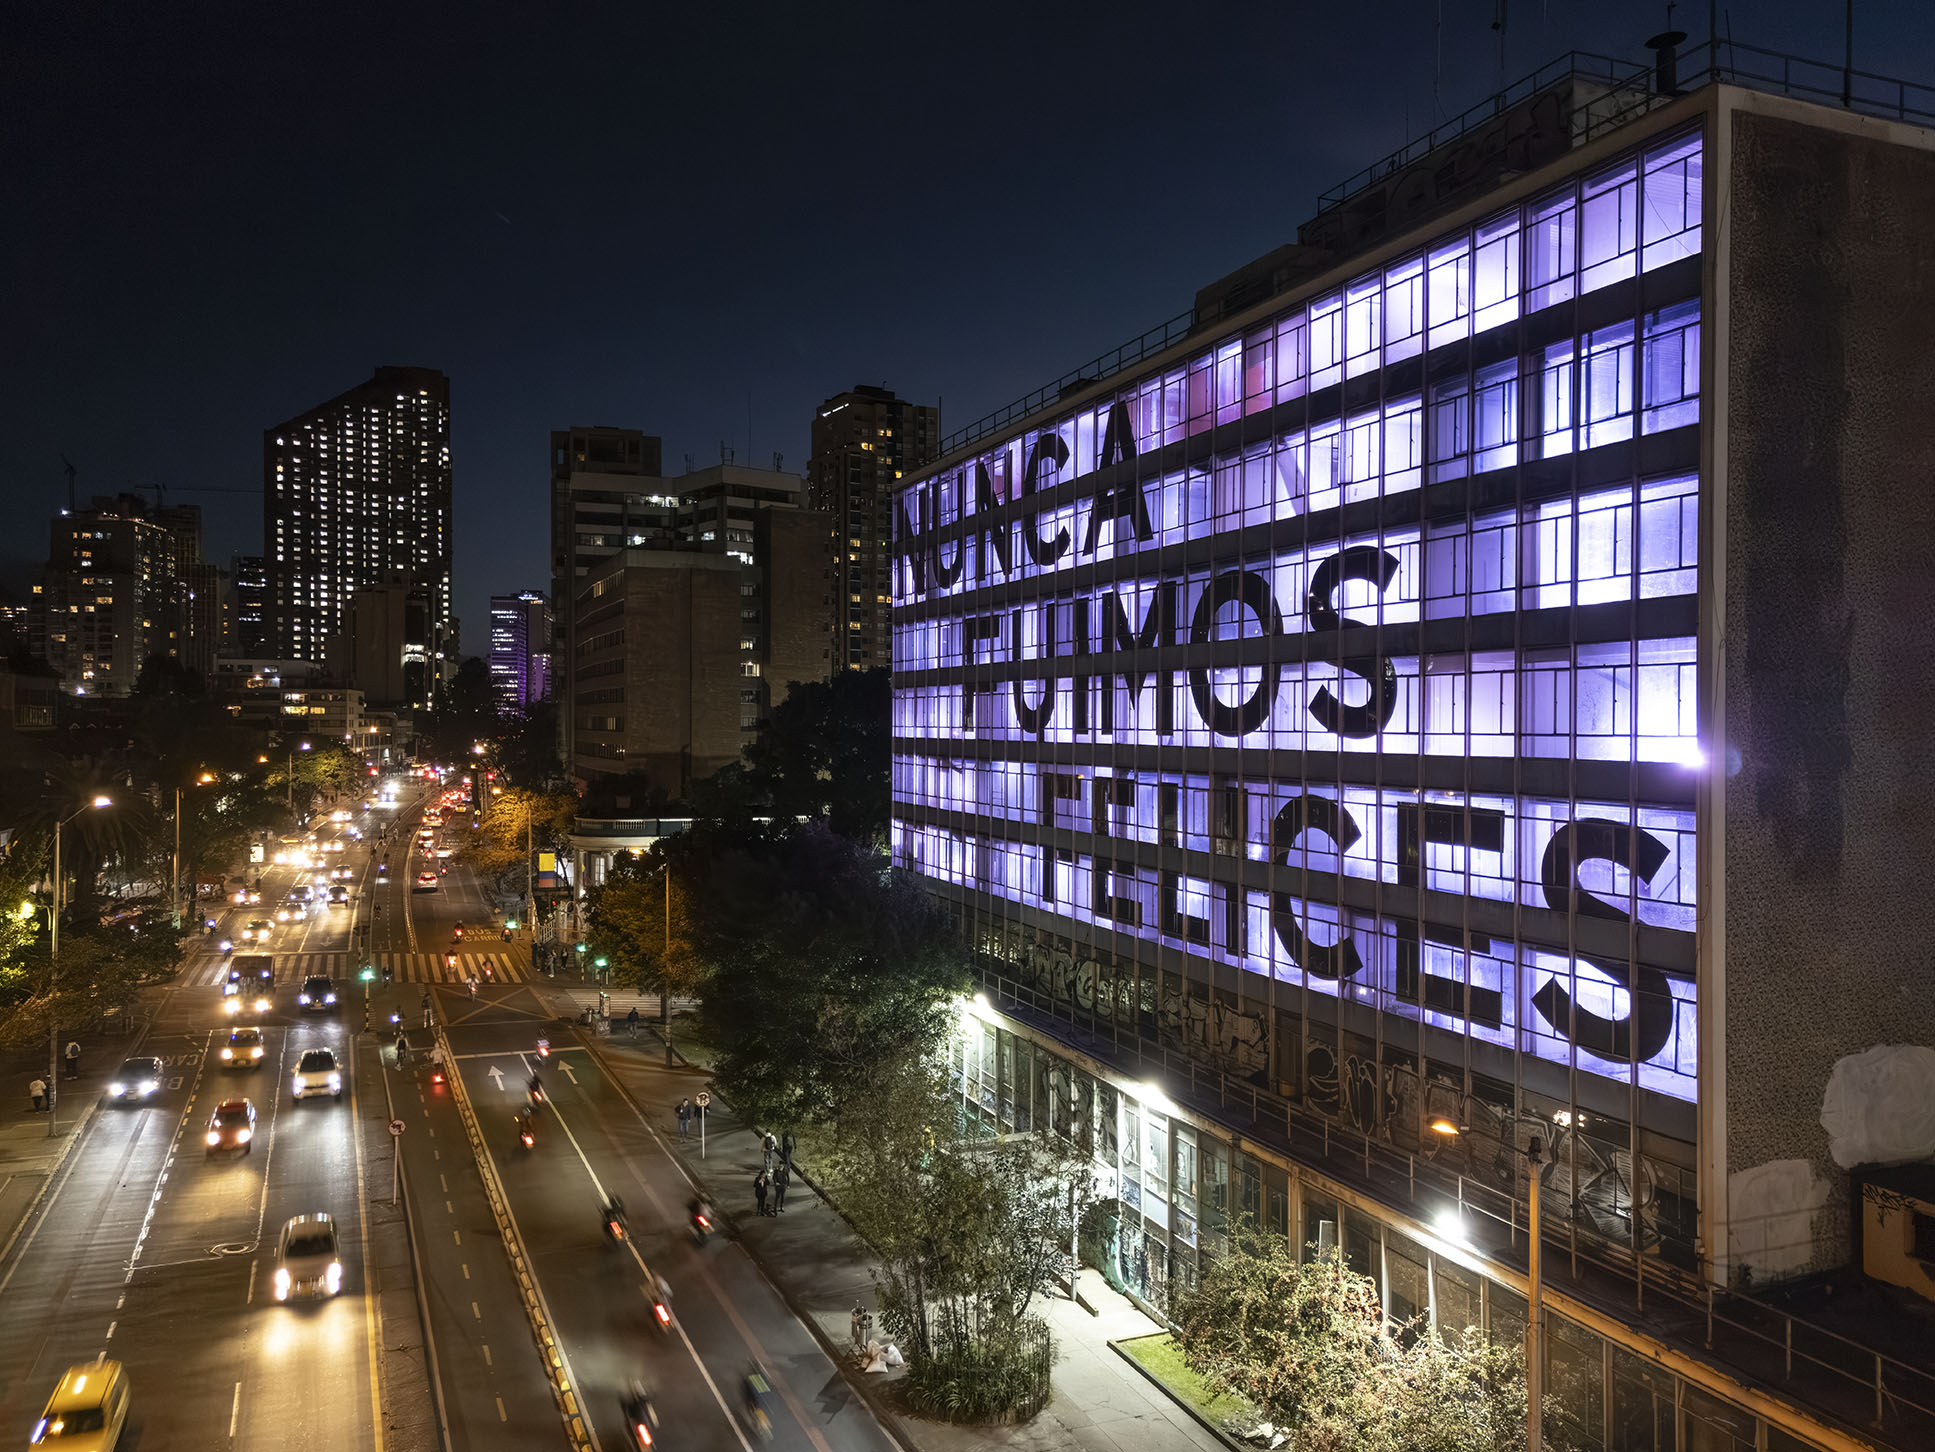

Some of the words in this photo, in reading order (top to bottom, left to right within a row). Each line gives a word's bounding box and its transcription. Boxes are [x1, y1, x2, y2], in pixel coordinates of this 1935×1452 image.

[893, 400, 1153, 599] NUNCA
[962, 545, 1400, 739] FUIMOS
[1043, 772, 1672, 1064] FELICES
